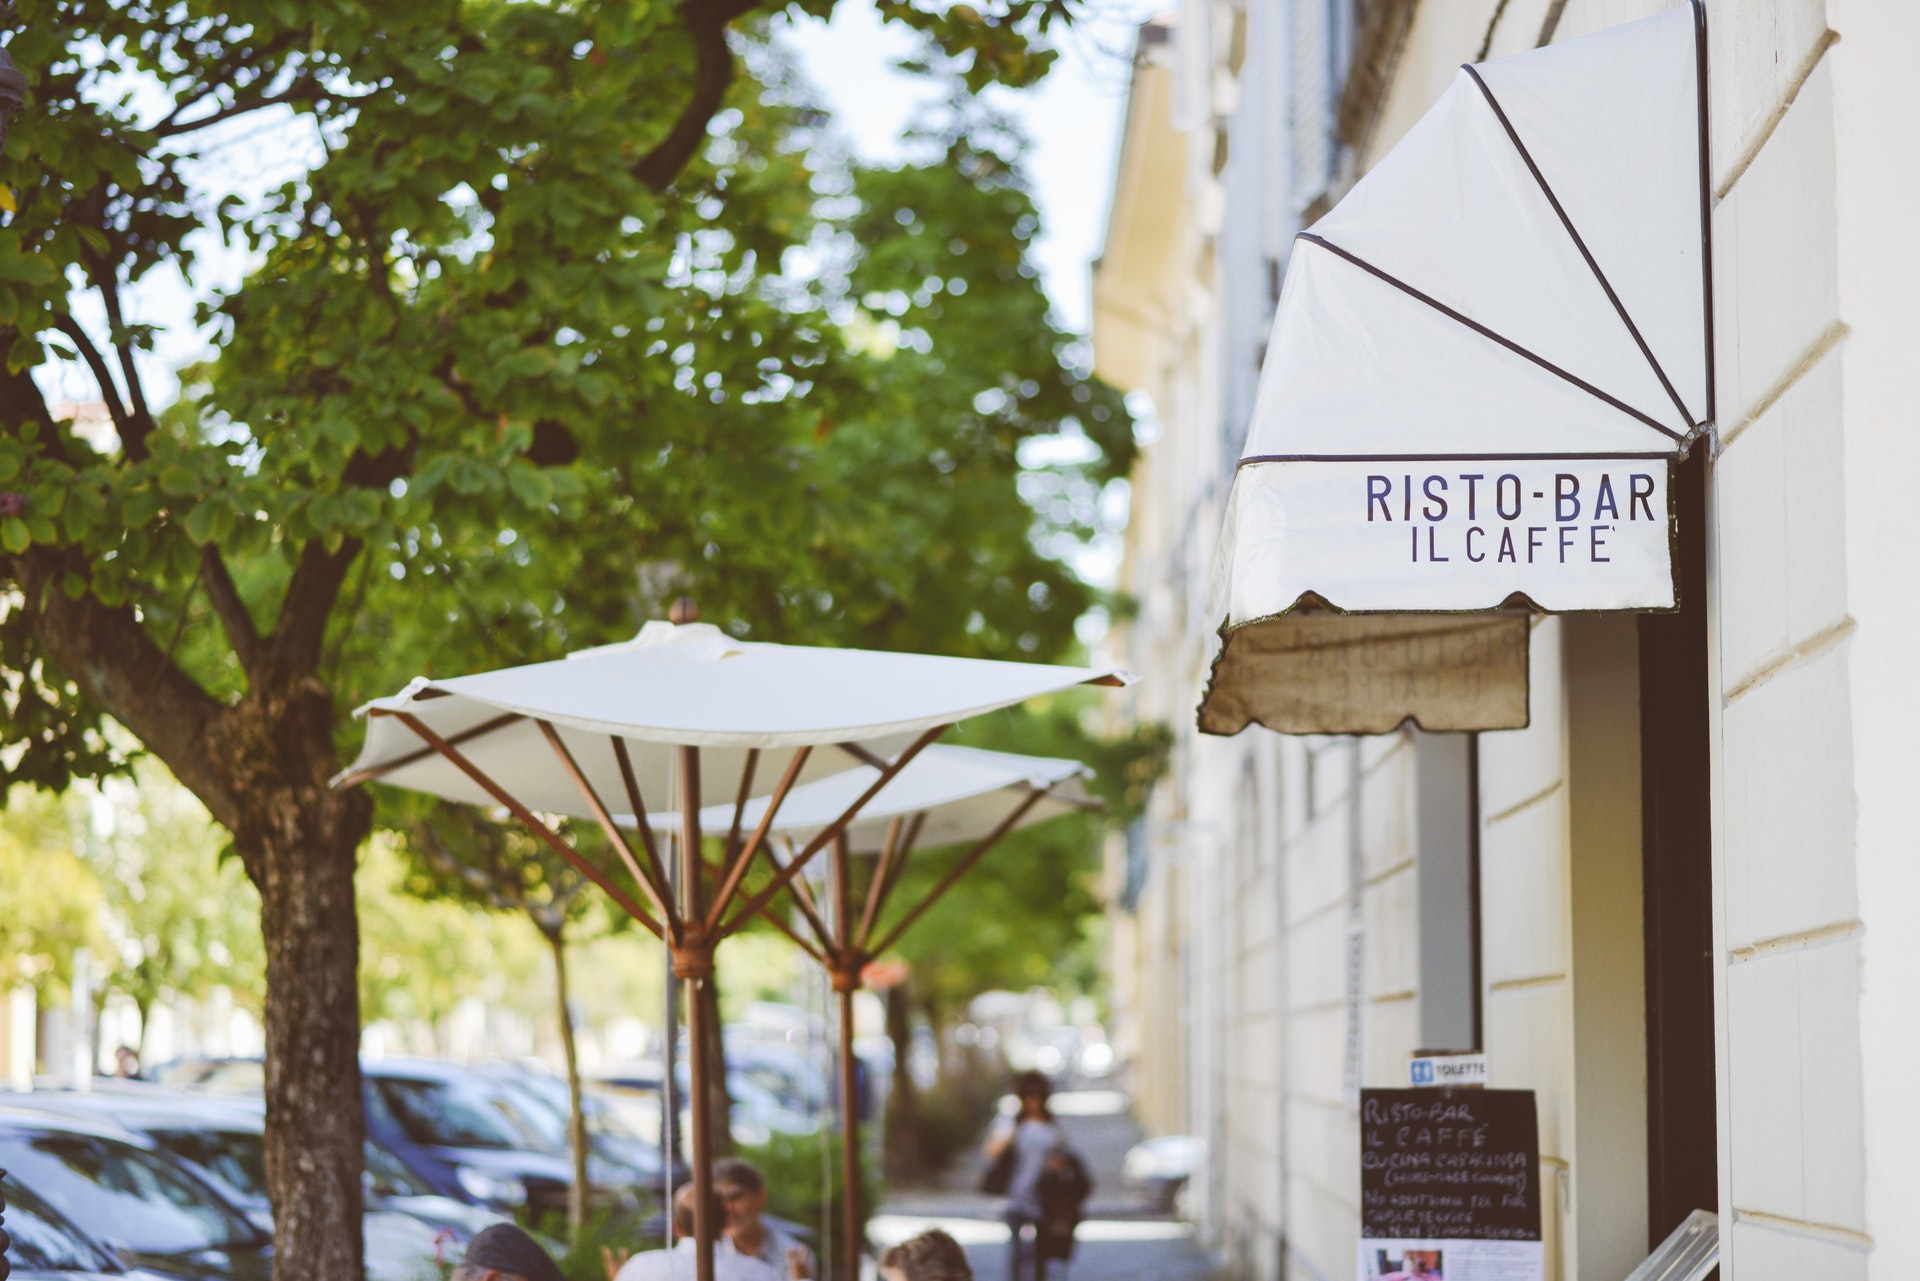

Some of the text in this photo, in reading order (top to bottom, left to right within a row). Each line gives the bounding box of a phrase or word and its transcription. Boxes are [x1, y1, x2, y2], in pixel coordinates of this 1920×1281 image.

[1367, 474, 1655, 521] RISTO-BAR
[1412, 526, 1449, 562] IL
[1366, 1130, 1384, 1147] IL
